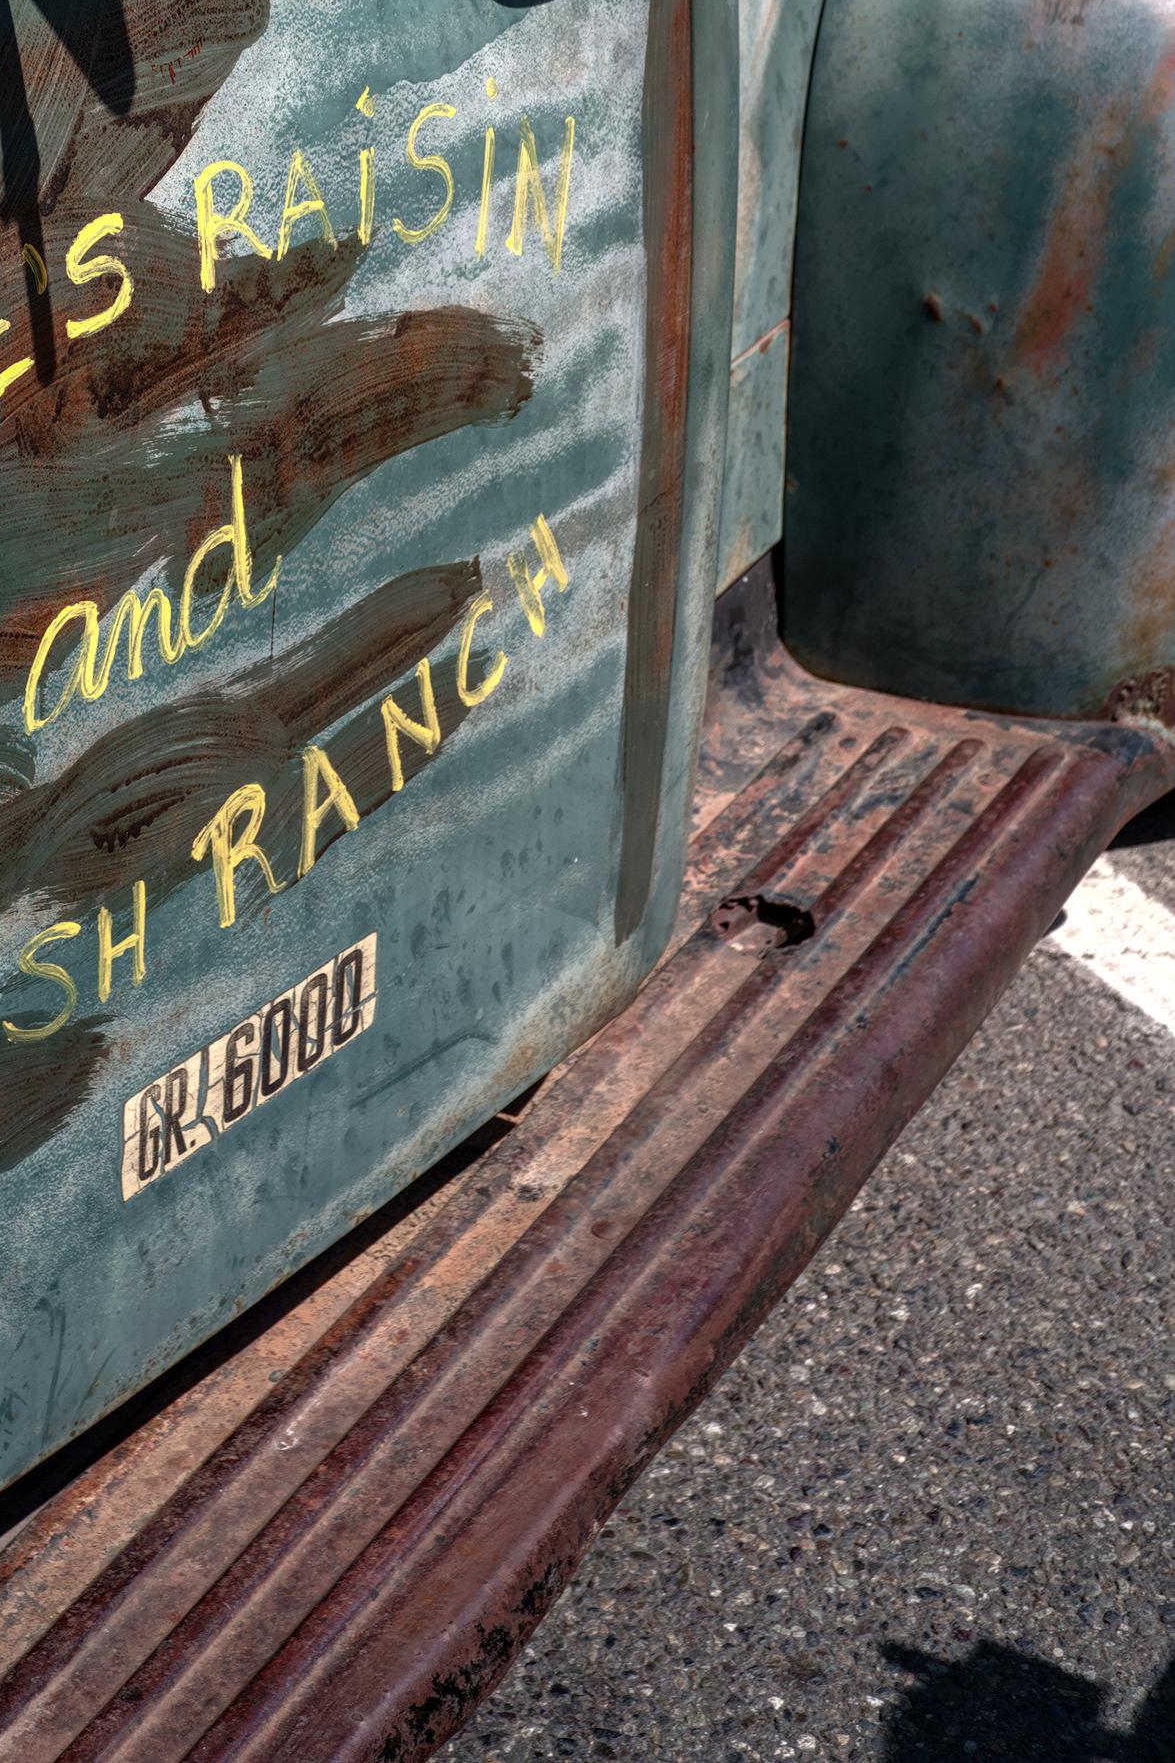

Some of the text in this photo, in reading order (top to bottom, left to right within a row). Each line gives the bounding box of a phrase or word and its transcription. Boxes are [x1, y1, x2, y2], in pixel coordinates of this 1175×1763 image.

[24, 454, 281, 734] and
[191, 513, 569, 928] RANCH
[138, 948, 363, 1181] GR. 6000
